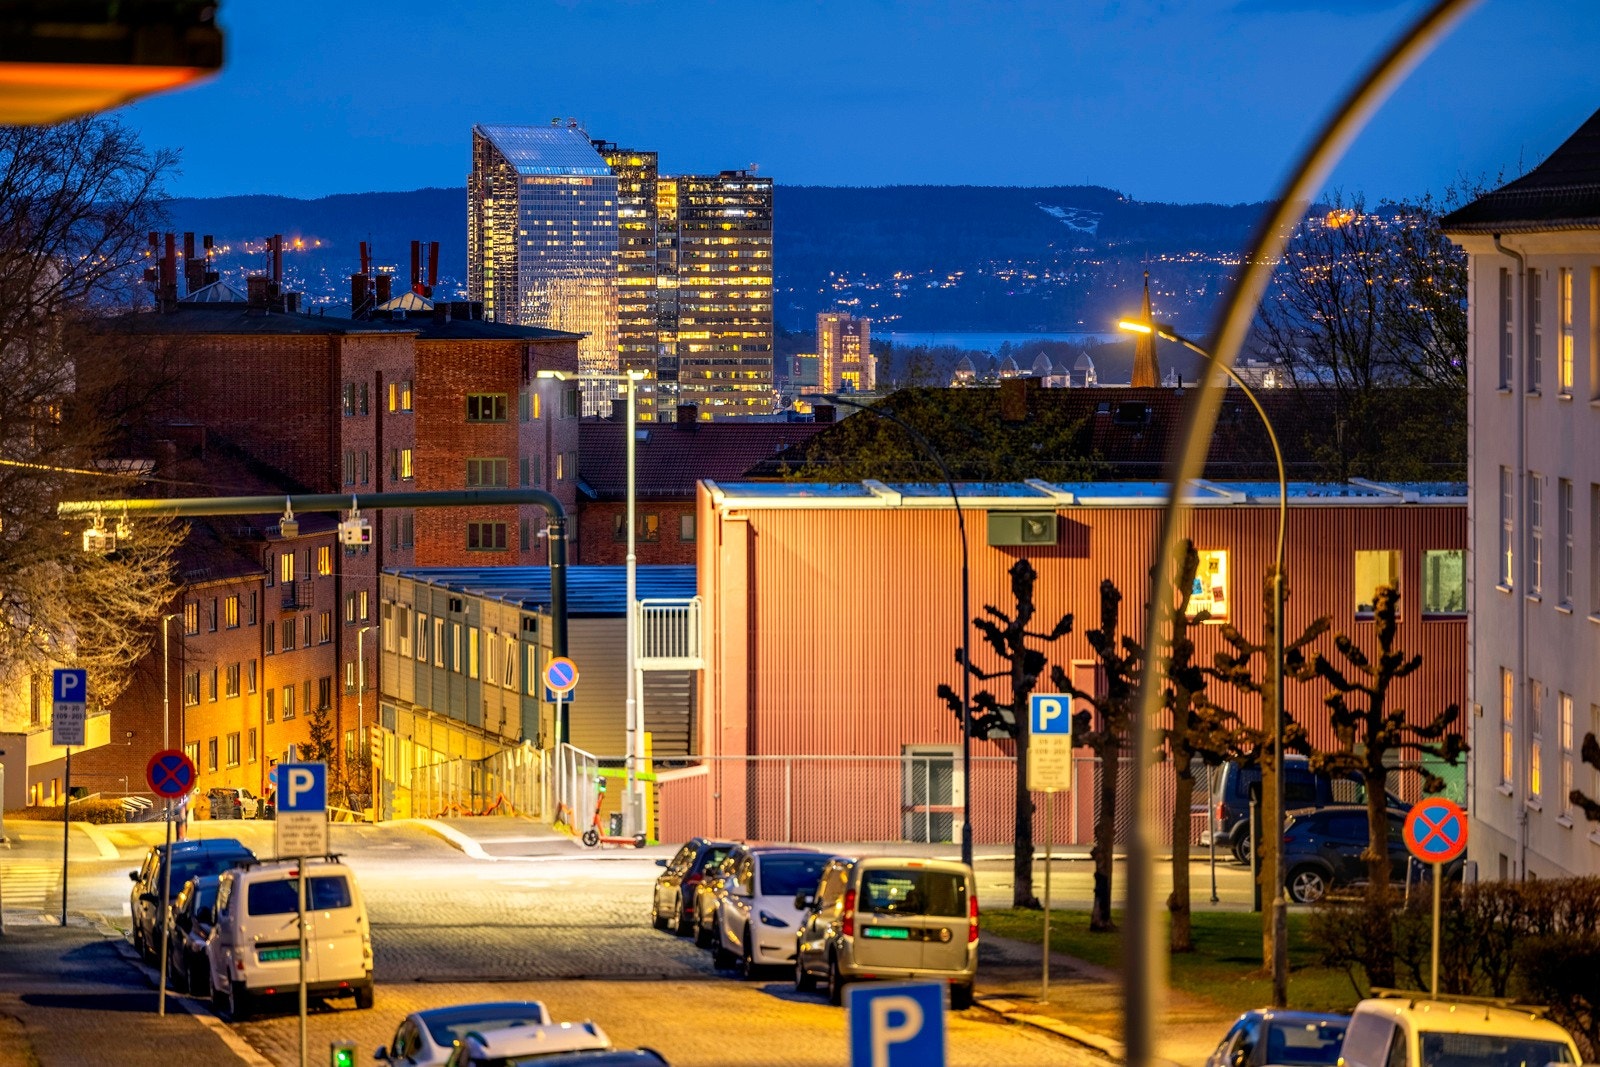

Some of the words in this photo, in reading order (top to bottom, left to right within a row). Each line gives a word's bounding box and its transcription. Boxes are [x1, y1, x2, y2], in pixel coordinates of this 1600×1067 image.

[61, 673, 79, 698] P
[1040, 699, 1062, 731] P
[288, 768, 315, 807] P
[870, 995, 924, 1067] P
